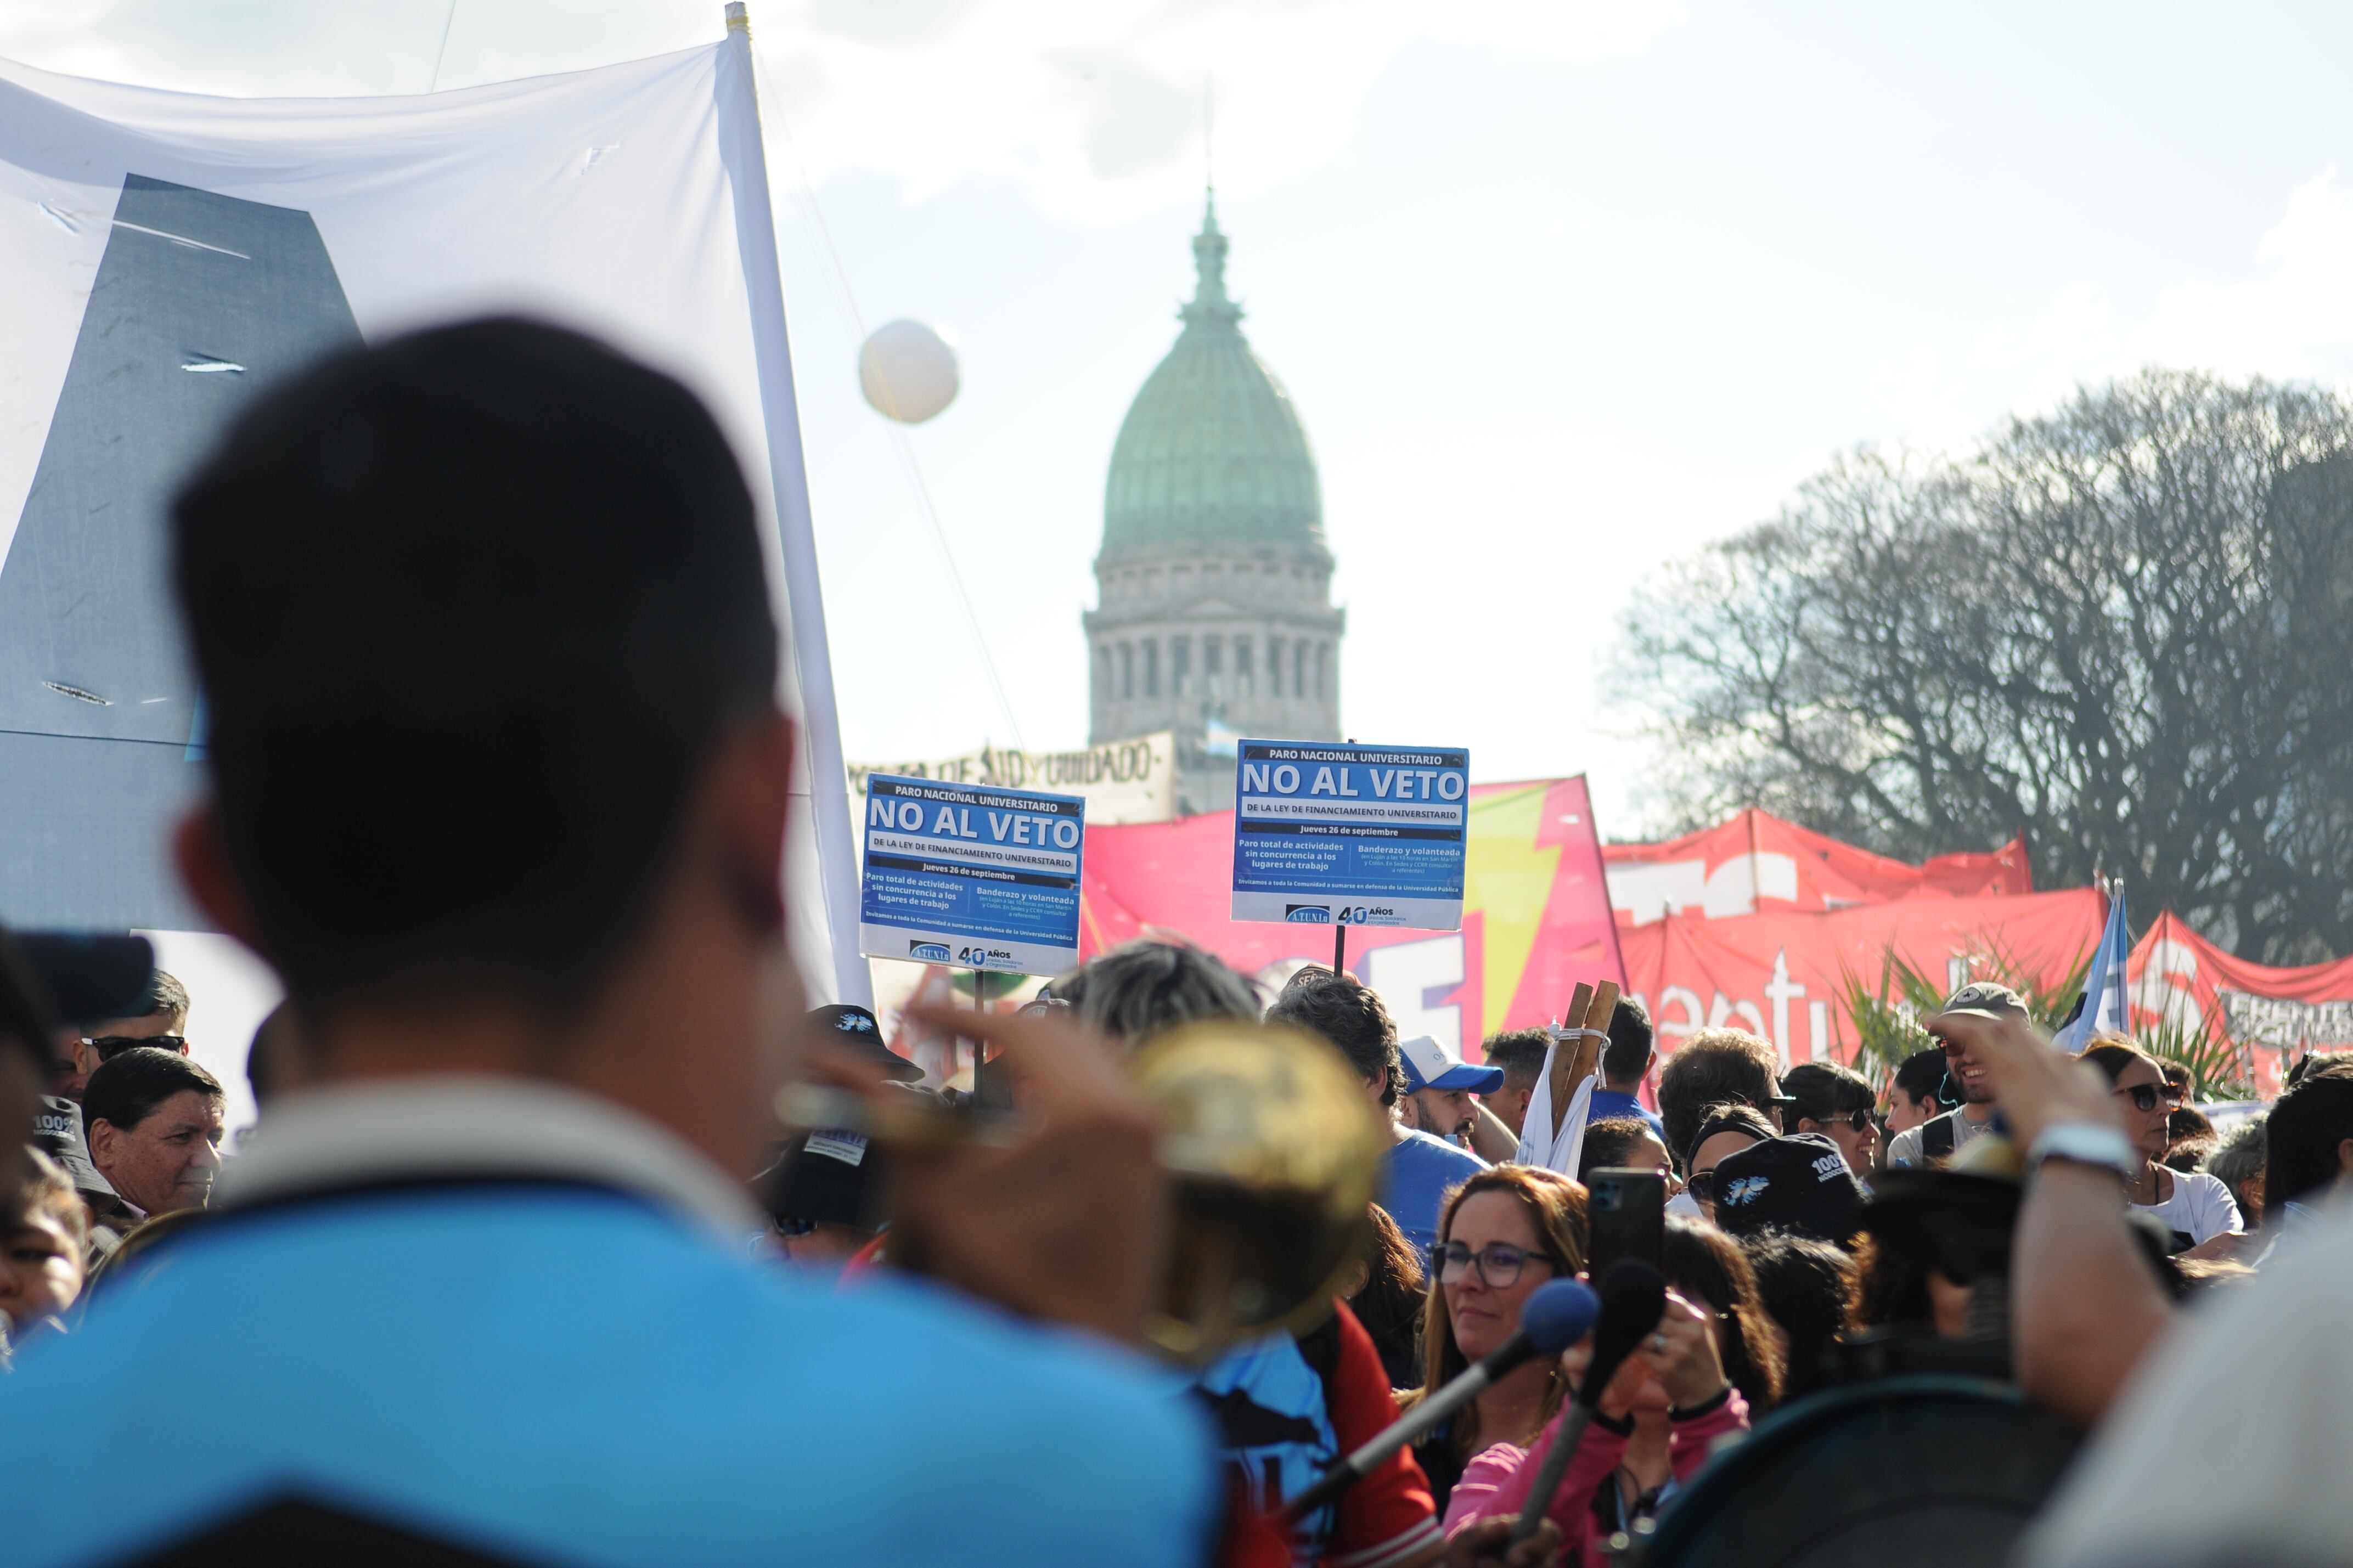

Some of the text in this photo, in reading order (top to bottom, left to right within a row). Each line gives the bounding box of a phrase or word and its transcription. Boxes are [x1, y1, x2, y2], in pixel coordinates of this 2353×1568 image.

[1270, 749, 1442, 765] PARO NACIONAL UNIVERSITARIO
[1242, 764, 1465, 800] NO AL VETO
[896, 786, 1058, 812] PARO NACIONAL UNIVERSITARIO
[1305, 806, 1385, 816] FINANCIAMIENTO
[1388, 809, 1456, 819] UNIVERSITARIO
[870, 798, 1079, 849] NO AL VETO
[1300, 825, 1327, 834] Jueves
[1352, 828, 1398, 837] septiembre
[1295, 842, 1343, 850] actividades
[1358, 845, 1403, 854] Banderazo
[1412, 848, 1460, 856] volanteada
[928, 844, 1003, 859] FINANCIAMIENTO
[1005, 853, 1071, 867] UNIVERSITARIO
[1260, 851, 1315, 860] concurrencia
[922, 863, 948, 873] Jueves
[971, 869, 1015, 881] septiembre
[1252, 860, 1284, 870] lugares
[1298, 862, 1329, 872] trabajo
[866, 872, 963, 891] Paro total de actividades
[886, 886, 936, 898] concurrencia
[977, 887, 1020, 899] Banderazo
[1028, 894, 1074, 905] volanteada
[878, 893, 949, 910] lugares de trabajo
[1338, 906, 1394, 924] 40 AÑOS
[866, 911, 892, 920] Invitamos
[917, 917, 946, 927] Comunidad
[1020, 930, 1052, 939] Universidad
[958, 947, 1011, 966] 40 AÑOS
[33, 1115, 75, 1134] 100%
